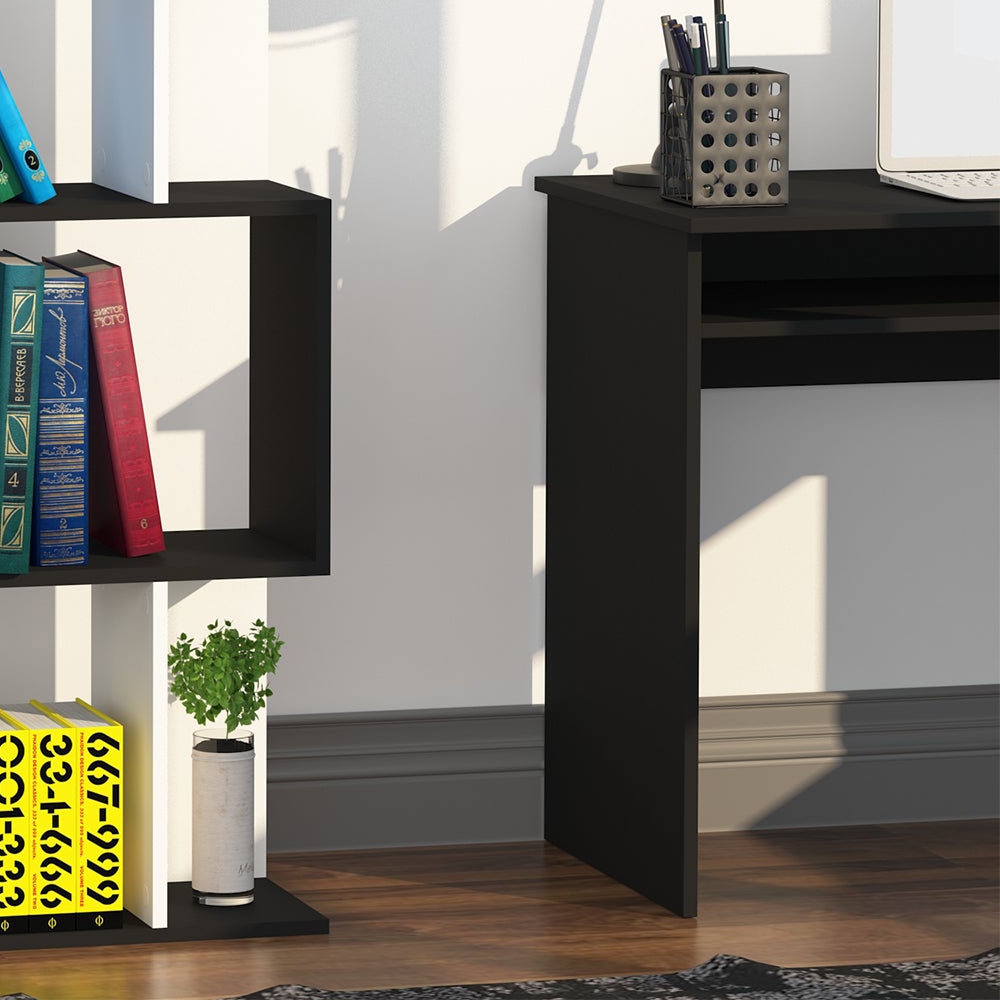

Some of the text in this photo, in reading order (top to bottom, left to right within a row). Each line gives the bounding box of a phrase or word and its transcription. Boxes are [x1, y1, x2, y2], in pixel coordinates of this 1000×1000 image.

[28, 155, 36, 166] 2
[93, 305, 124, 317] ВИКТОР
[93, 313, 125, 328] ГЮГО
[8, 472, 19, 488] 4
[59, 518, 67, 529] 2
[140, 518, 149, 529] 6
[40, 734, 73, 909] 334-666
[87, 732, 120, 905] 667-999
